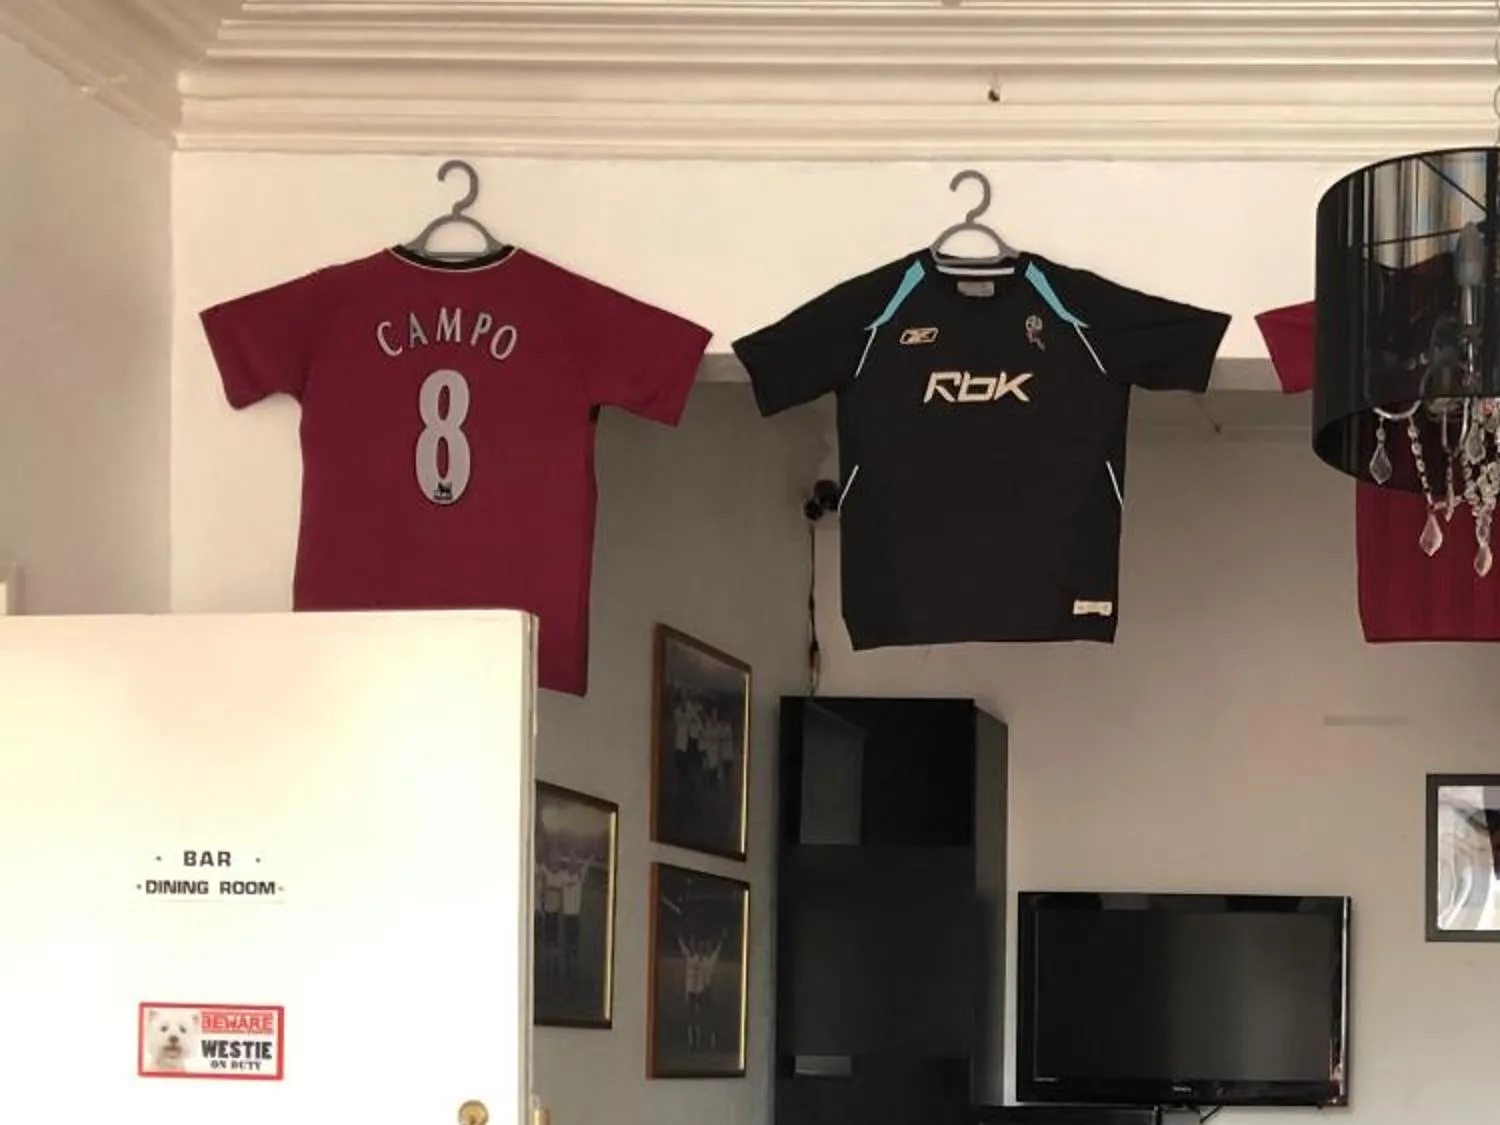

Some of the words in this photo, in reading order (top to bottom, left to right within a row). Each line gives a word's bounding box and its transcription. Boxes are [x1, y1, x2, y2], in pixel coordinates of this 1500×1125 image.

[377, 307, 518, 360] CAMPO
[415, 369, 471, 505] 8
[183, 850, 232, 867] BAR
[145, 880, 209, 895] DINING
[219, 880, 276, 895] ROOM
[201, 1013, 273, 1030] BEWARE
[201, 1039, 273, 1060] WESTIE
[210, 1060, 227, 1070] ON
[231, 1060, 262, 1071] DUTY
